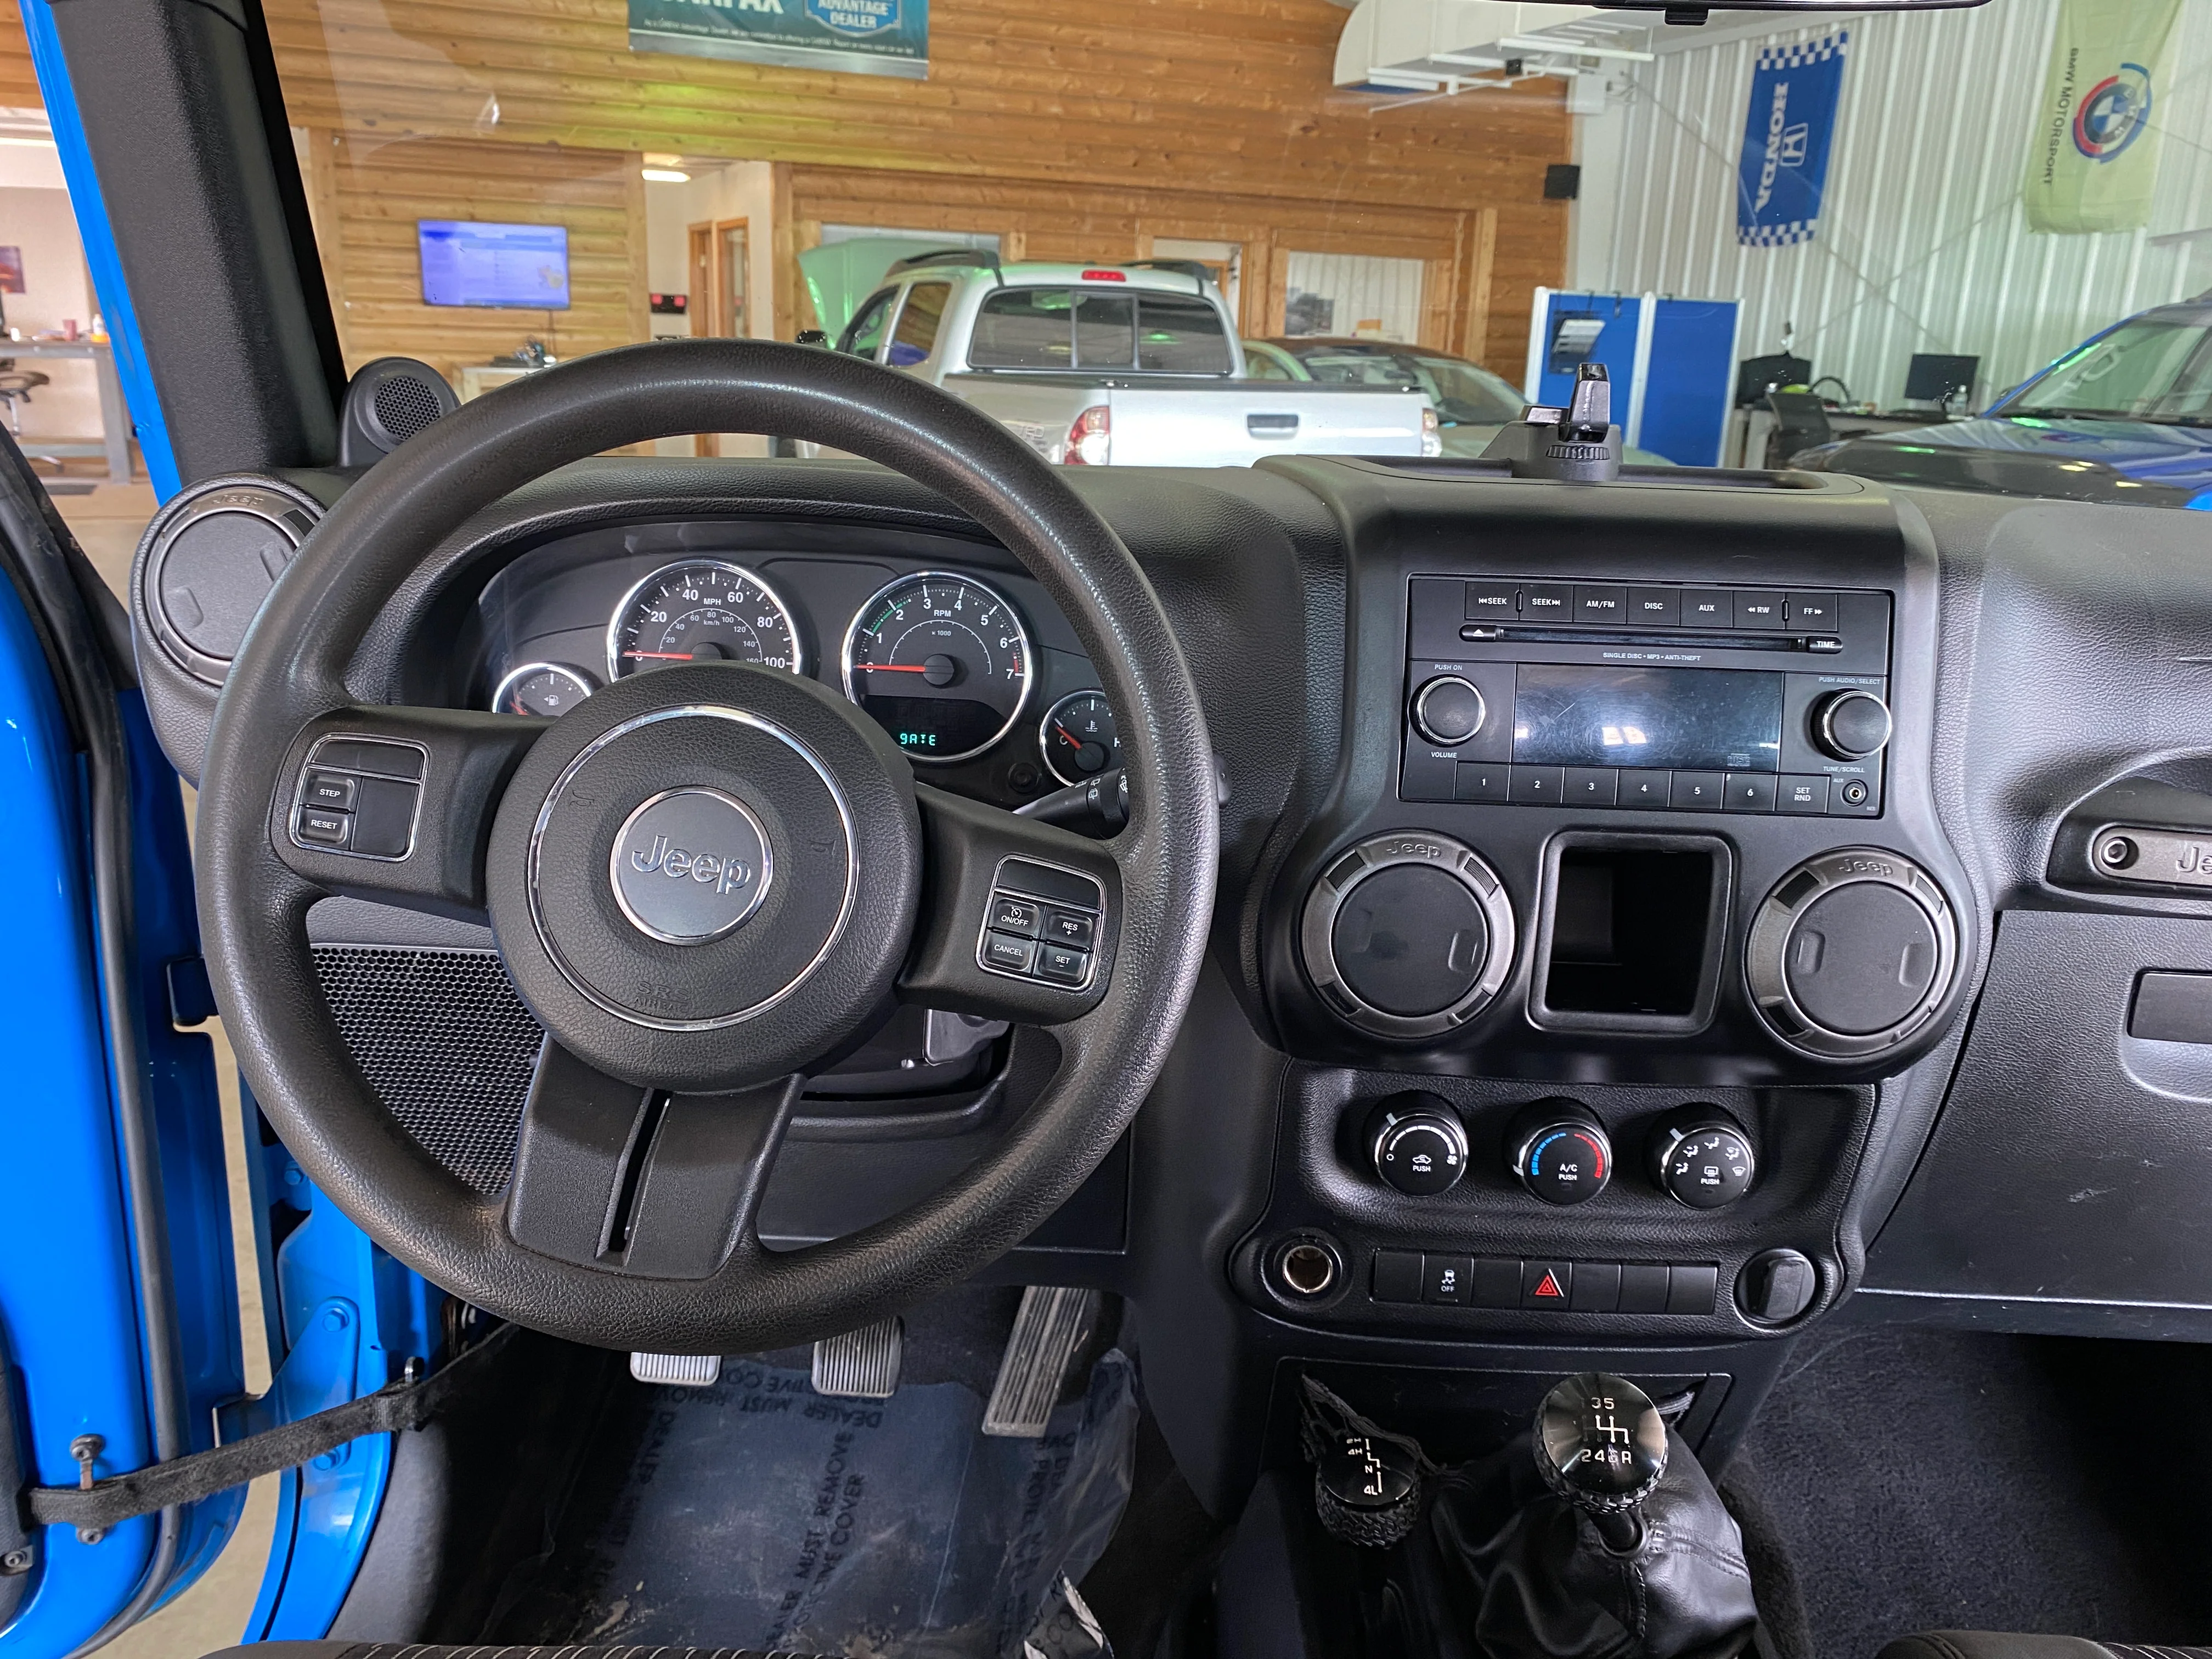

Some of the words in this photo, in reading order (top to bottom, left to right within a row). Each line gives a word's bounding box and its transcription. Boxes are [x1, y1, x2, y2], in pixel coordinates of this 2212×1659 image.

[830, 11, 877, 28] DEALER
[2065, 48, 2079, 83] BMW
[2044, 86, 2073, 186] MOTORSPORT
[1754, 82, 1790, 213] HONDA
[213, 495, 264, 506] Jeep
[682, 589, 698, 601] 40
[727, 591, 743, 603] 60
[923, 598, 932, 610] 3
[954, 600, 962, 611] 4
[1586, 601, 1615, 609] AM/FM
[650, 611, 667, 623] 20
[896, 610, 904, 620] 2
[980, 615, 989, 626] 5
[757, 617, 773, 628] 80
[876, 633, 883, 644] 1
[1000, 637, 1008, 648] 6
[764, 657, 786, 669] 100
[1006, 669, 1014, 680] 7
[1481, 778, 1486, 786] 1
[1534, 780, 1541, 788] 2
[319, 789, 341, 797] STEP
[1694, 787, 1701, 795] 5
[311, 819, 337, 830] RESET
[1385, 841, 1441, 859] Jeep
[631, 835, 751, 895] Jeep
[1838, 859, 1893, 877] Jeep
[1001, 915, 1029, 927] ON/OFF
[1062, 922, 1078, 931] RES
[994, 944, 1023, 957] CANCEL
[1055, 955, 1070, 964] SET
[1559, 1163, 1578, 1173] A/C
[812, 1431, 854, 1517] REMOVE
[1364, 1465, 1373, 1474] N
[1363, 1485, 1378, 1496] 4L
[829, 1474, 865, 1546] COVER
